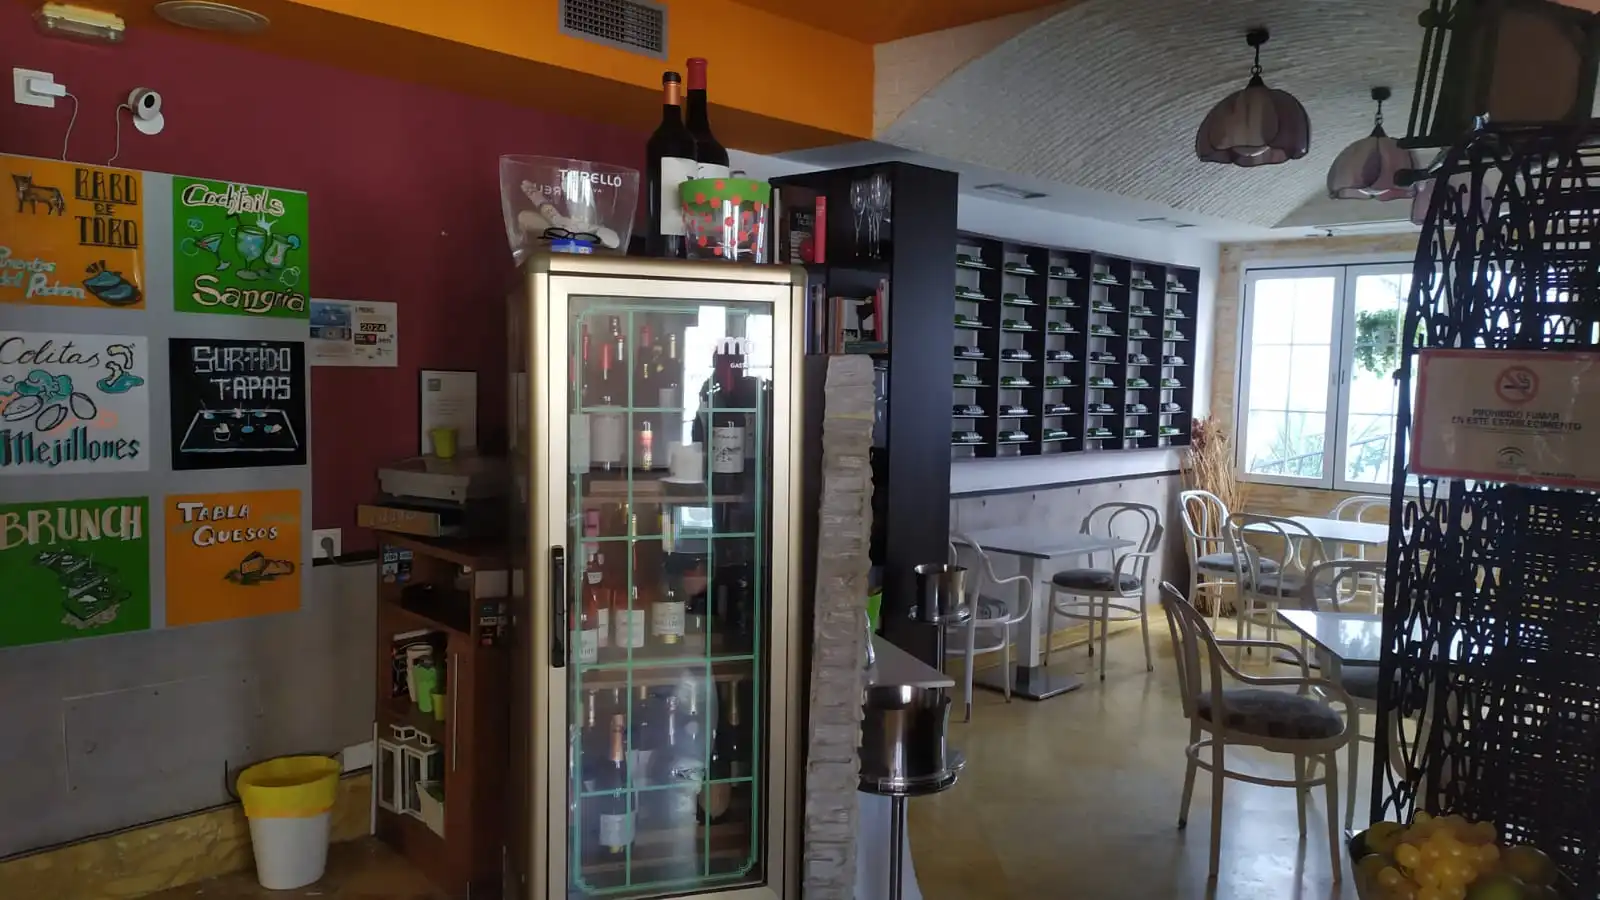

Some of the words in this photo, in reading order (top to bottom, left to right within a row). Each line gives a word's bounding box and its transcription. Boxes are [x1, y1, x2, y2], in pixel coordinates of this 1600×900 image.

[362, 323, 385, 332] 2024
[0, 336, 100, 368] Colitas
[193, 345, 291, 373] SURTIDO
[210, 377, 291, 400] TAPAS
[1451, 416, 1464, 425] EN
[1466, 417, 1488, 426] ESTE
[1472, 408, 1523, 418] PROHIBIDO
[1526, 410, 1560, 421] FUMAR
[0, 426, 140, 468] Mejillones
[176, 502, 249, 523] TABLA
[0, 505, 142, 550] BRUNCH
[192, 525, 278, 548] QUESOS
